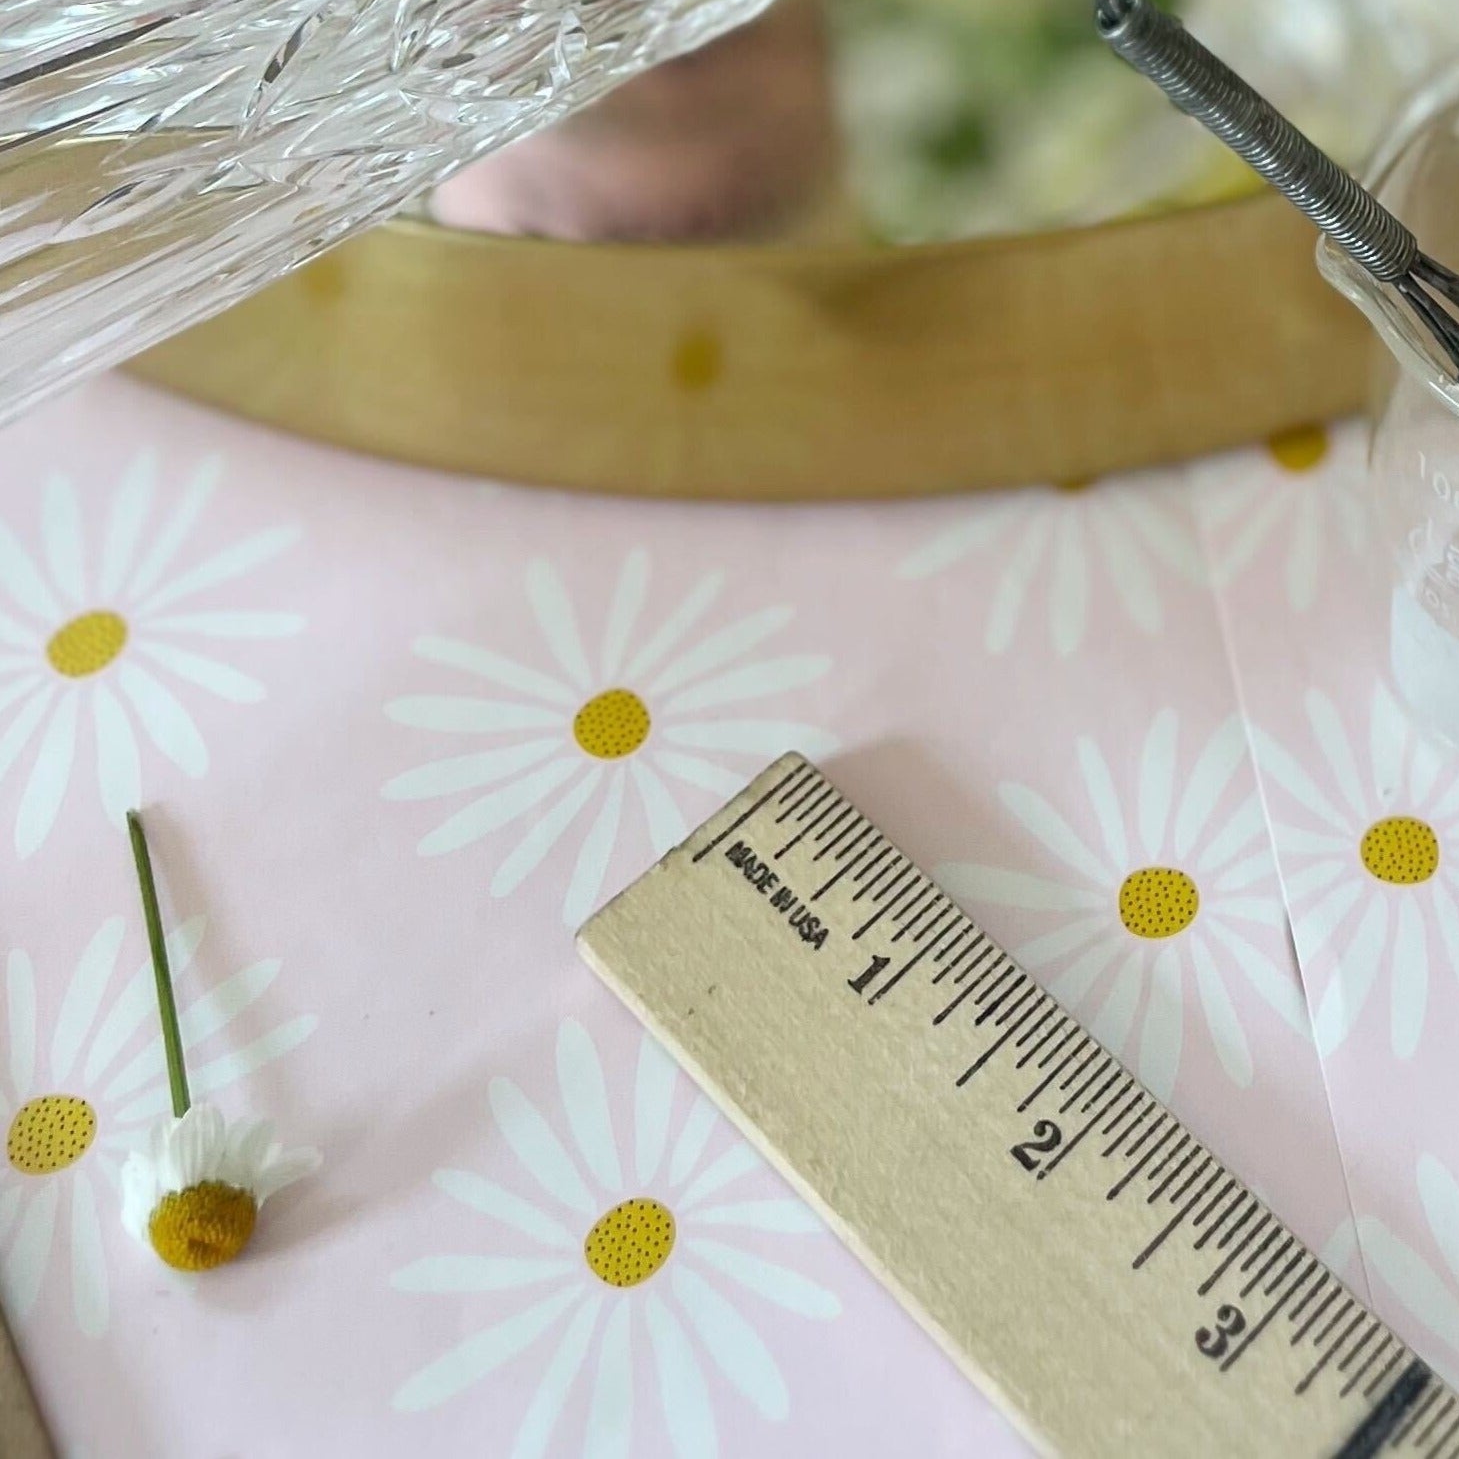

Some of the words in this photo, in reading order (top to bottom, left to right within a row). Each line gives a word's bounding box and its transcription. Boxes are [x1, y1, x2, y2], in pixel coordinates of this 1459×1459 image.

[725, 840, 780, 894] MADE
[770, 886, 798, 913] IN
[788, 904, 829, 951] USA
[847, 954, 891, 995] 1
[1010, 1119, 1063, 1173] 2
[1195, 1303, 1247, 1358] 3
